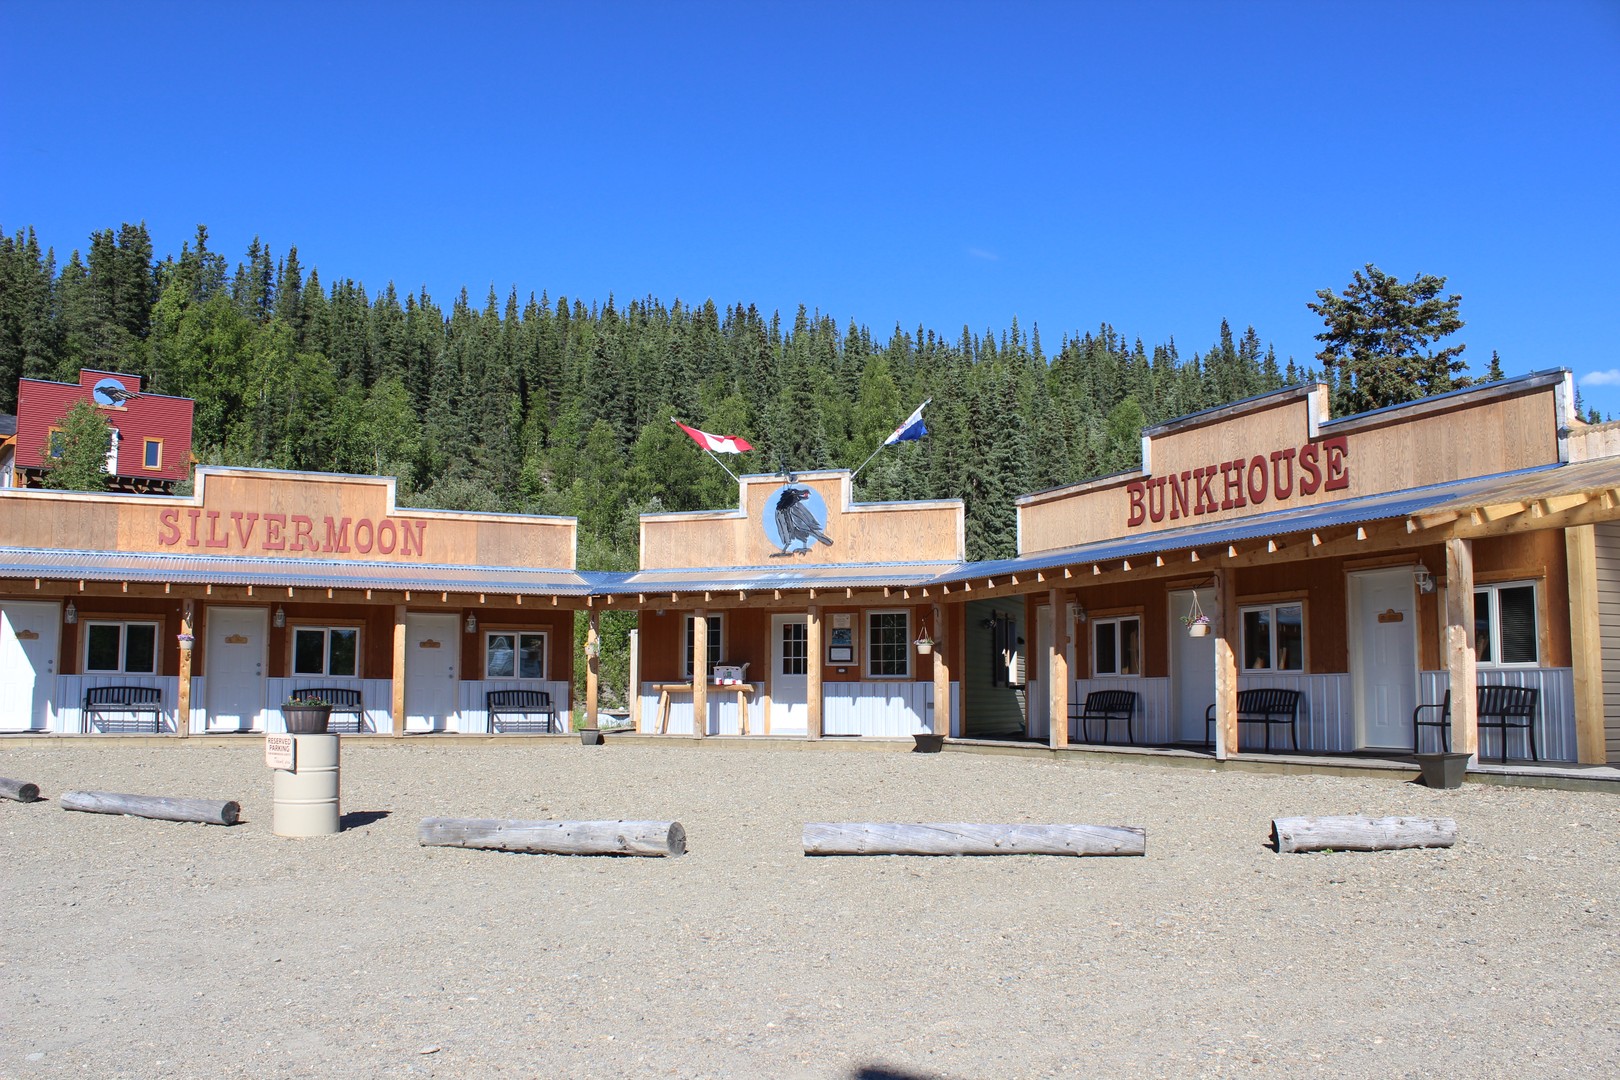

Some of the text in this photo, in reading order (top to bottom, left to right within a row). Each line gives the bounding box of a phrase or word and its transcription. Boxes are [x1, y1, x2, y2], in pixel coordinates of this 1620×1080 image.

[1127, 436, 1349, 527] BUNKHOUSE
[158, 509, 427, 556] SILVERMOON
[267, 737, 291, 745] RESERVED
[269, 744, 290, 752] PARKING
